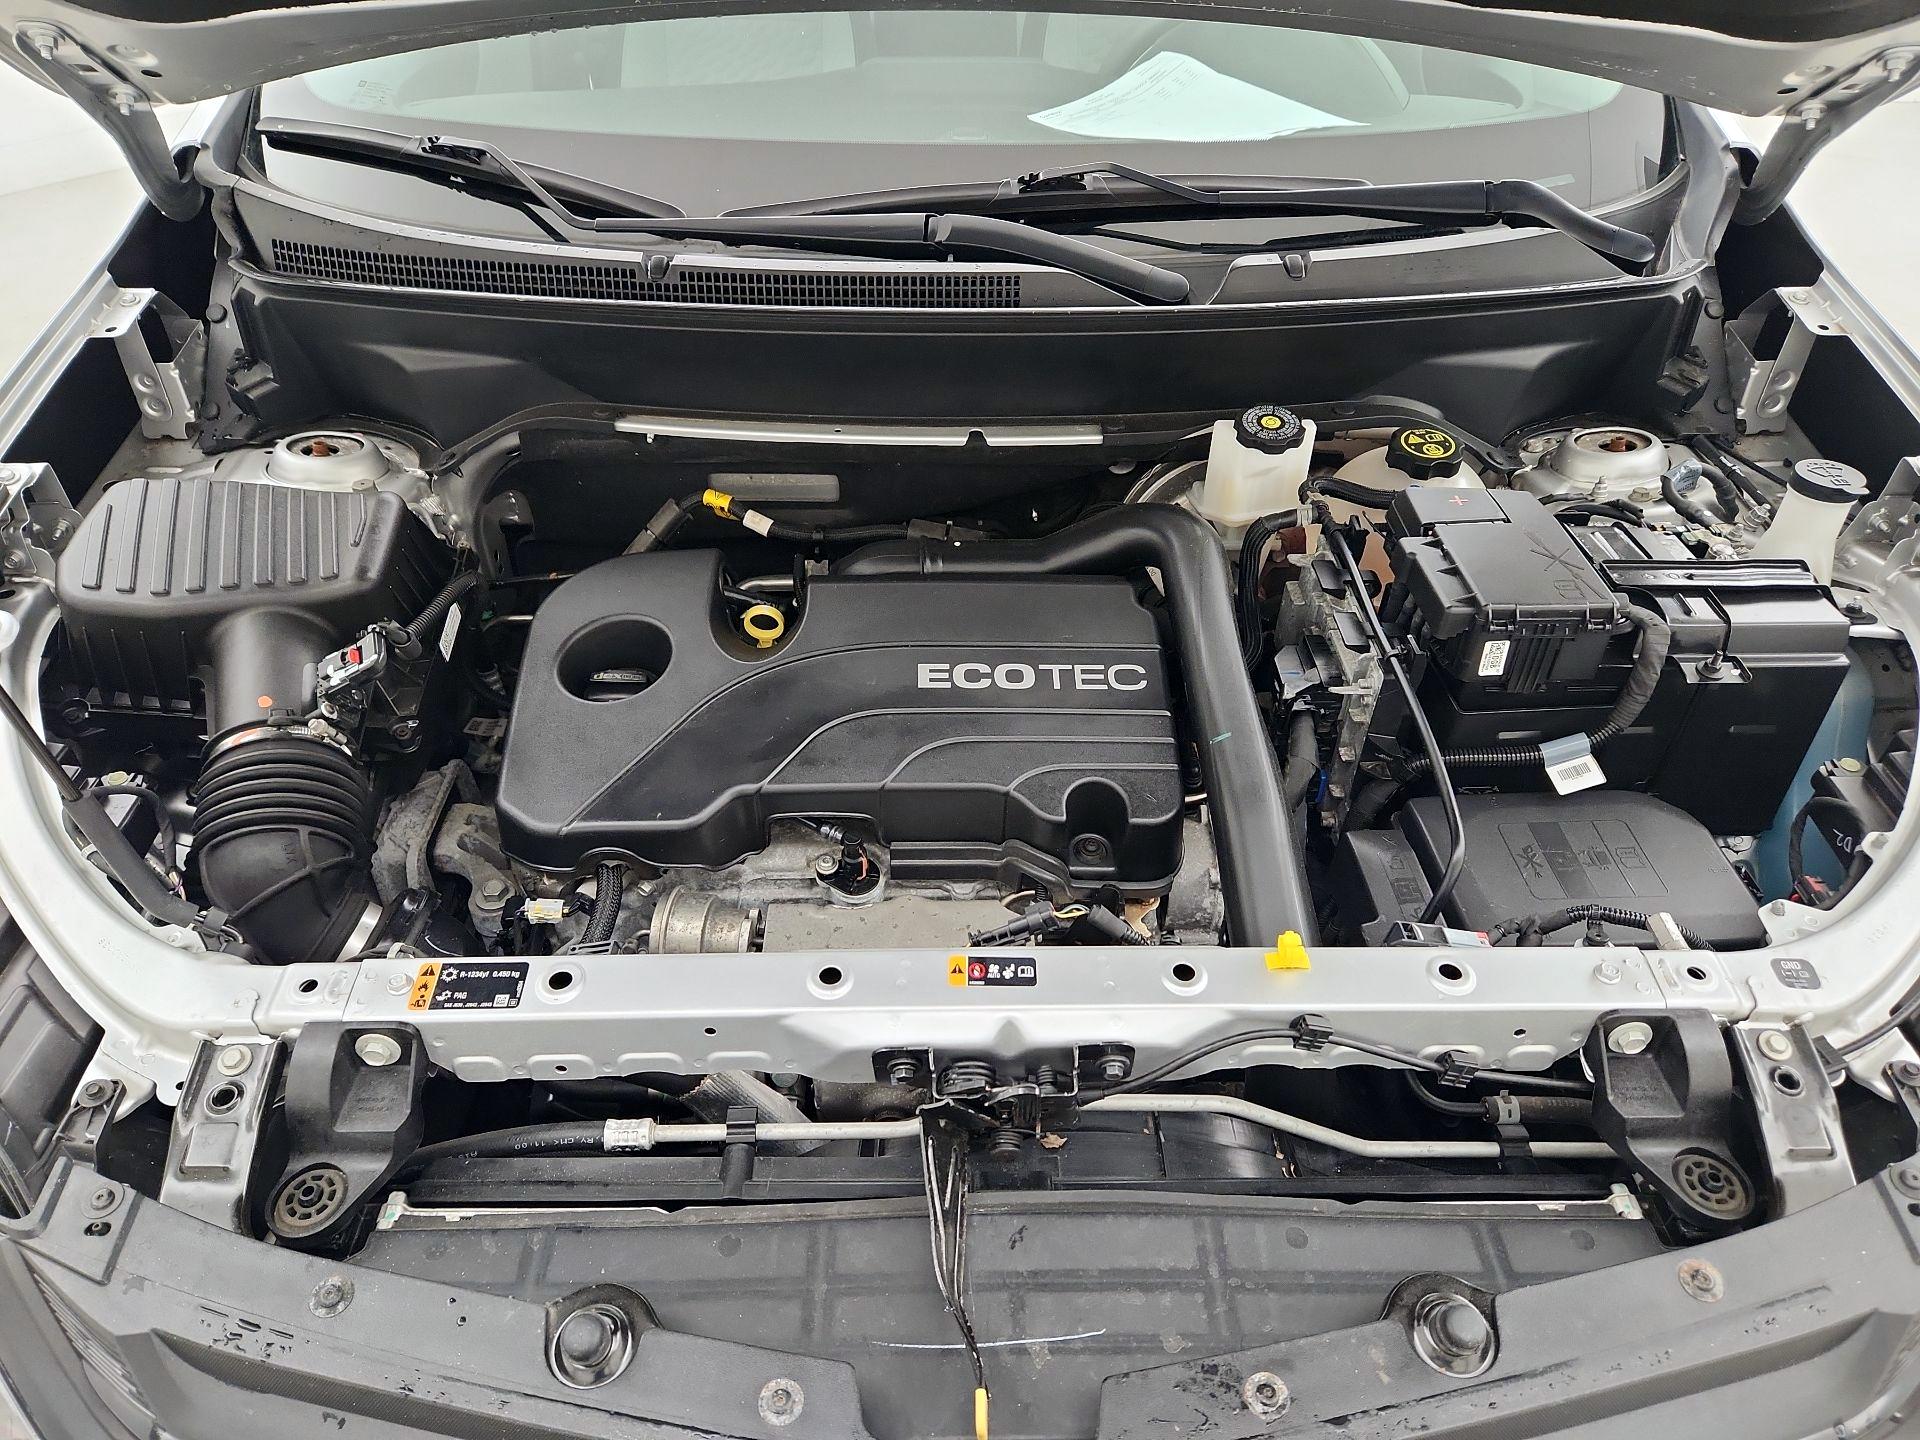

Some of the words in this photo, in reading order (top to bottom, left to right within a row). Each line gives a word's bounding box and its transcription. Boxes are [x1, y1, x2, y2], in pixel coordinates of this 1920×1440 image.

[917, 662, 1148, 691] ECOTEC
[1780, 960, 1801, 970] GND
[511, 971, 520, 979] kg
[453, 992, 467, 1000] PAG
